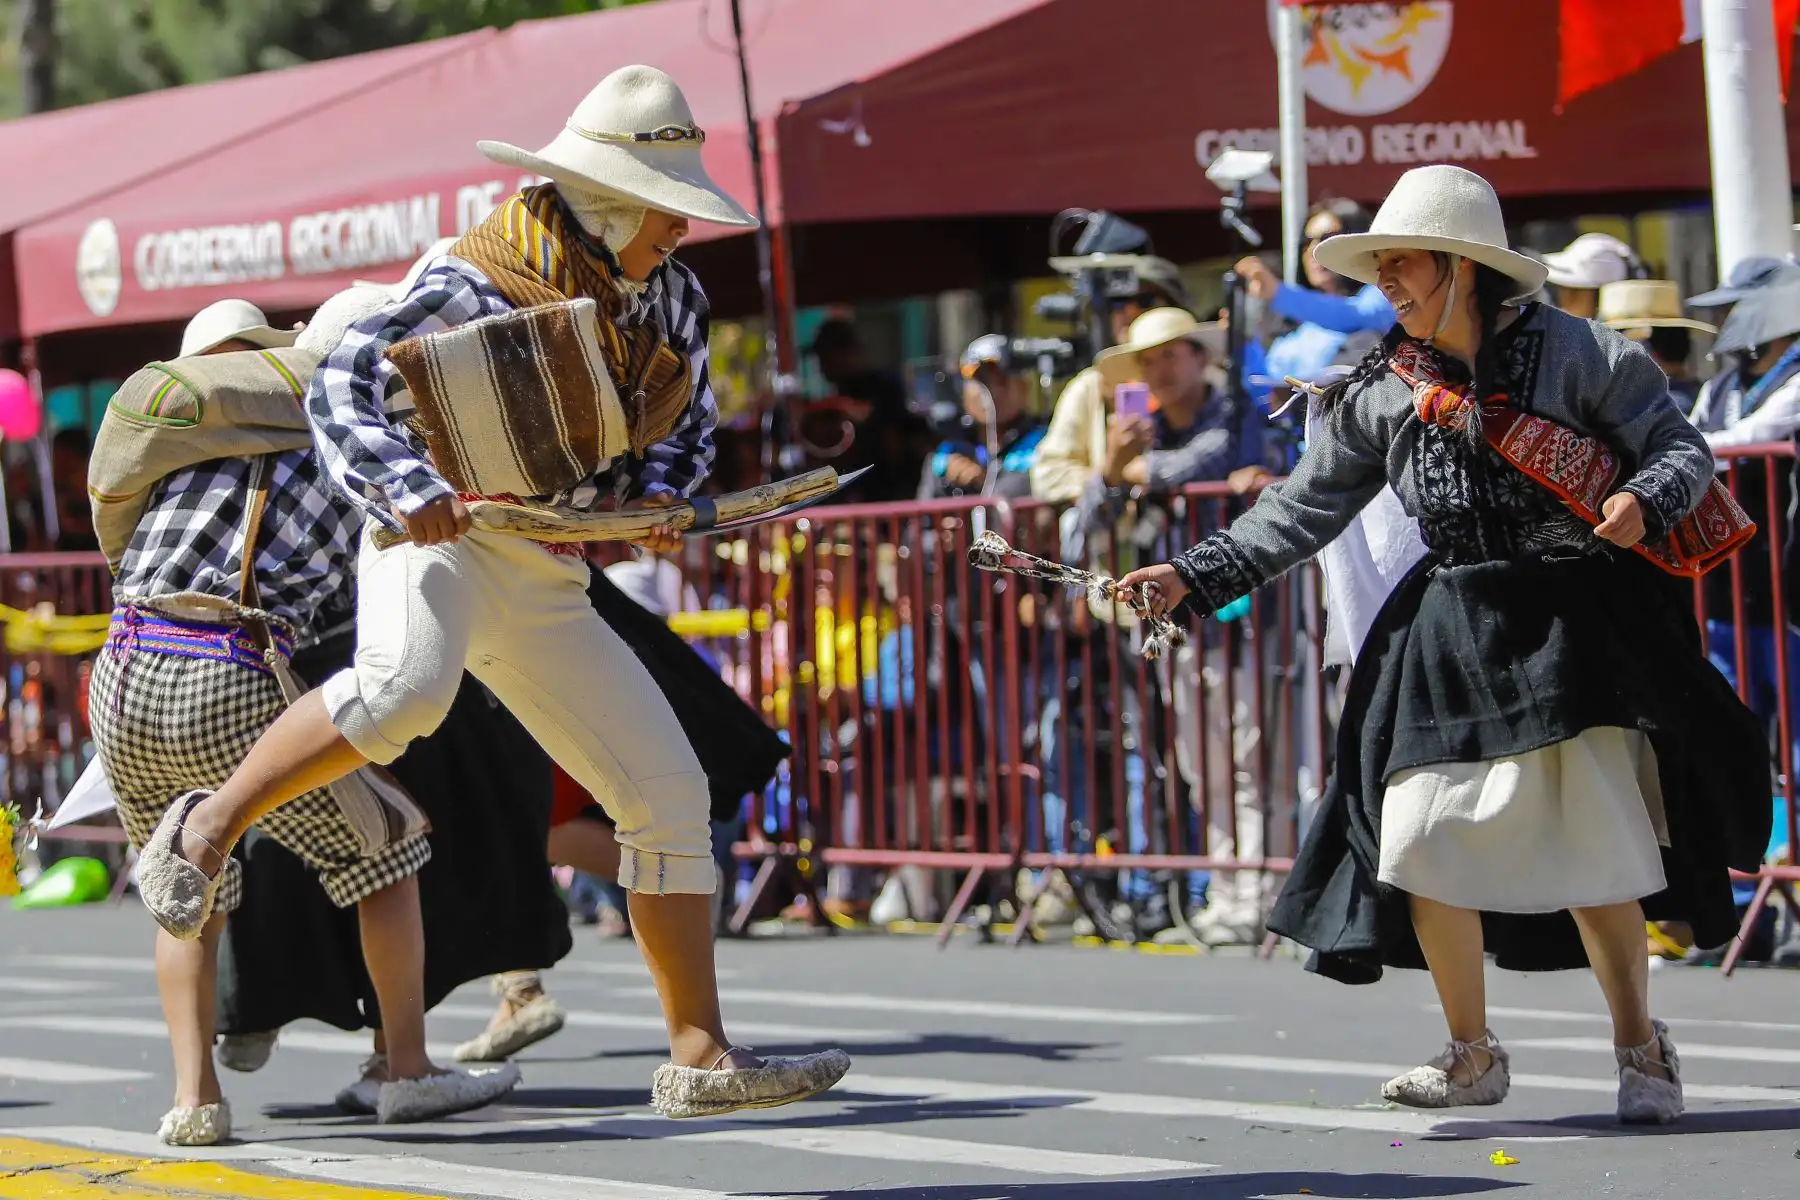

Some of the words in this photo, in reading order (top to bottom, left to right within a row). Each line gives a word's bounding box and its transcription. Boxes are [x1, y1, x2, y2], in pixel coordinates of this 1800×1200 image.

[1371, 120, 1538, 163] REGIONAL
[136, 222, 284, 290] GOBIERNO
[292, 194, 440, 272] REGIONAL
